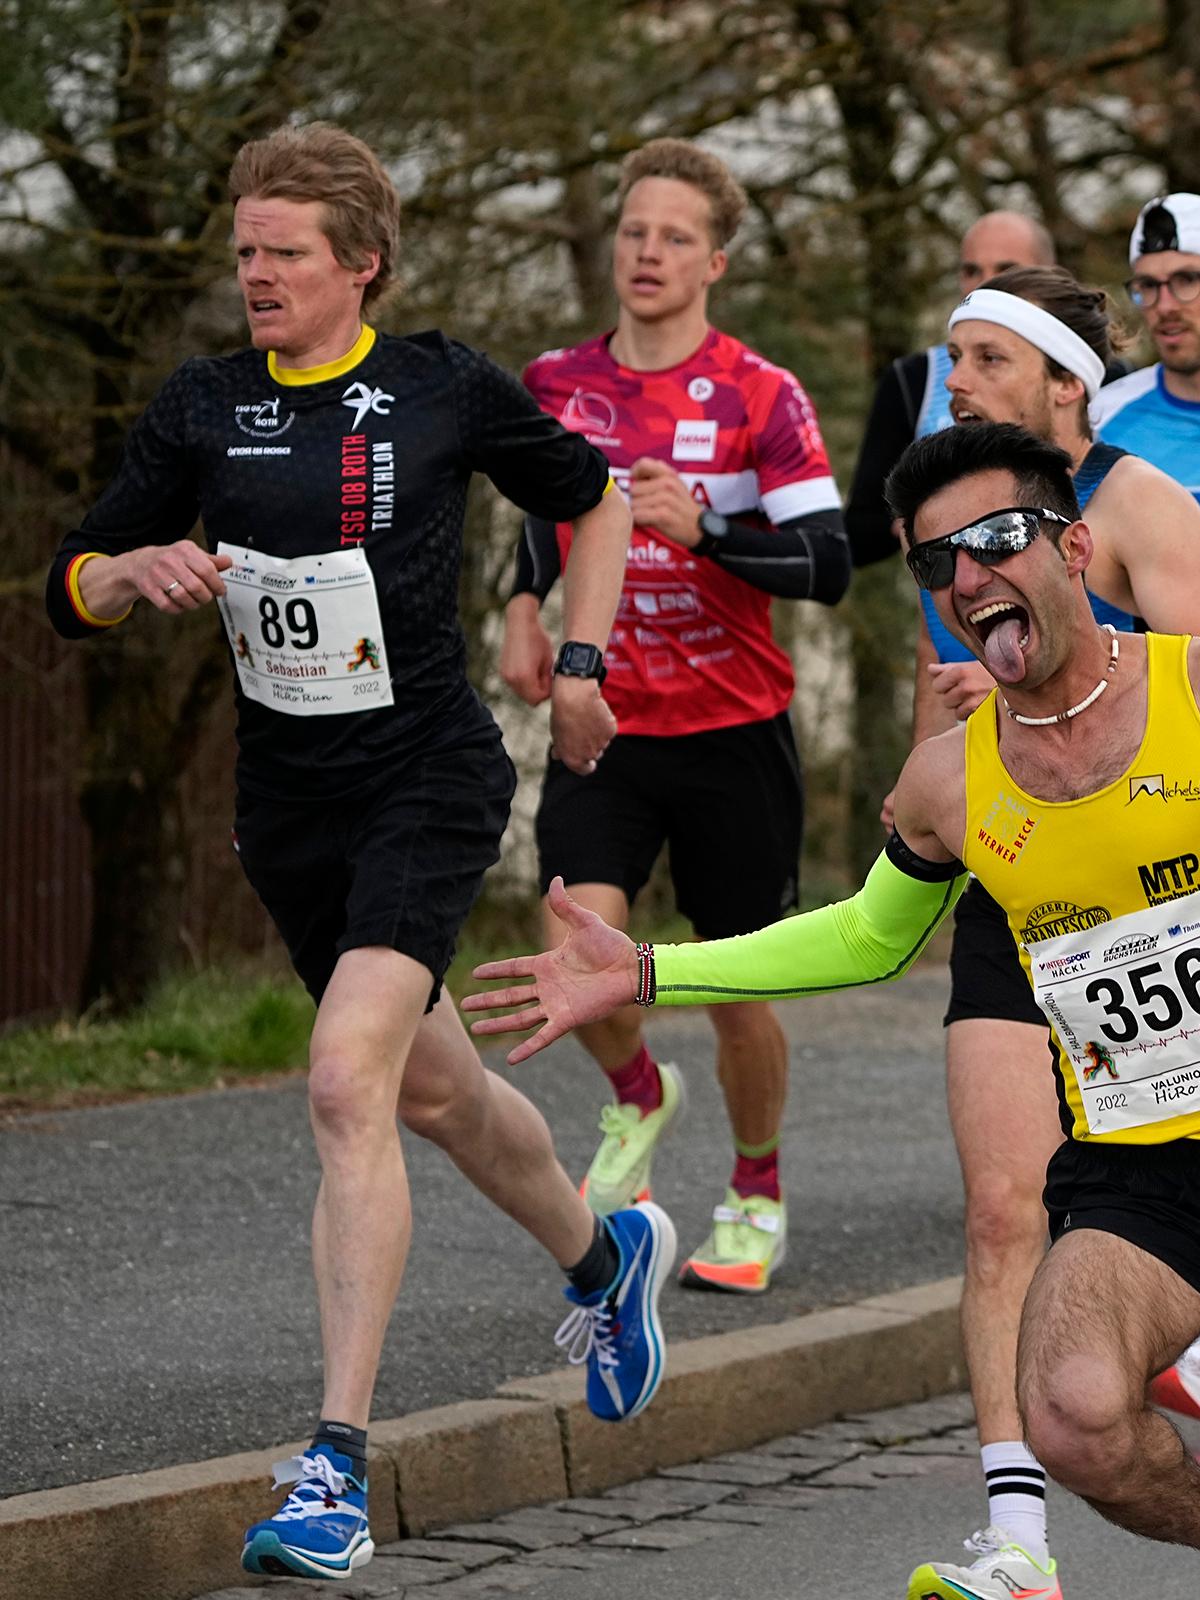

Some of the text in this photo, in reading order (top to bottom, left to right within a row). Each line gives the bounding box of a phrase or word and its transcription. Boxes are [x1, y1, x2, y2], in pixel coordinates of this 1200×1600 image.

[340, 434, 367, 545] TSG 08 ROTH
[372, 441, 394, 531] TRIATHLON
[259, 595, 319, 650] 89
[265, 660, 327, 678] Sebastian
[301, 694, 332, 703] Run
[352, 681, 380, 695] 2022
[978, 817, 1035, 864] WERNER BECK
[1138, 853, 1199, 897] MTP
[1023, 911, 1098, 945] FRANCESCO
[1027, 903, 1077, 928] PIZZERIA
[1045, 950, 1091, 971] INTERSPORT
[1103, 942, 1159, 963] BUCHSTALLER
[1044, 992, 1082, 1050] HALBMARATHON
[1096, 1093, 1129, 1112] 2022
[1154, 1082, 1199, 1105] HiRo
